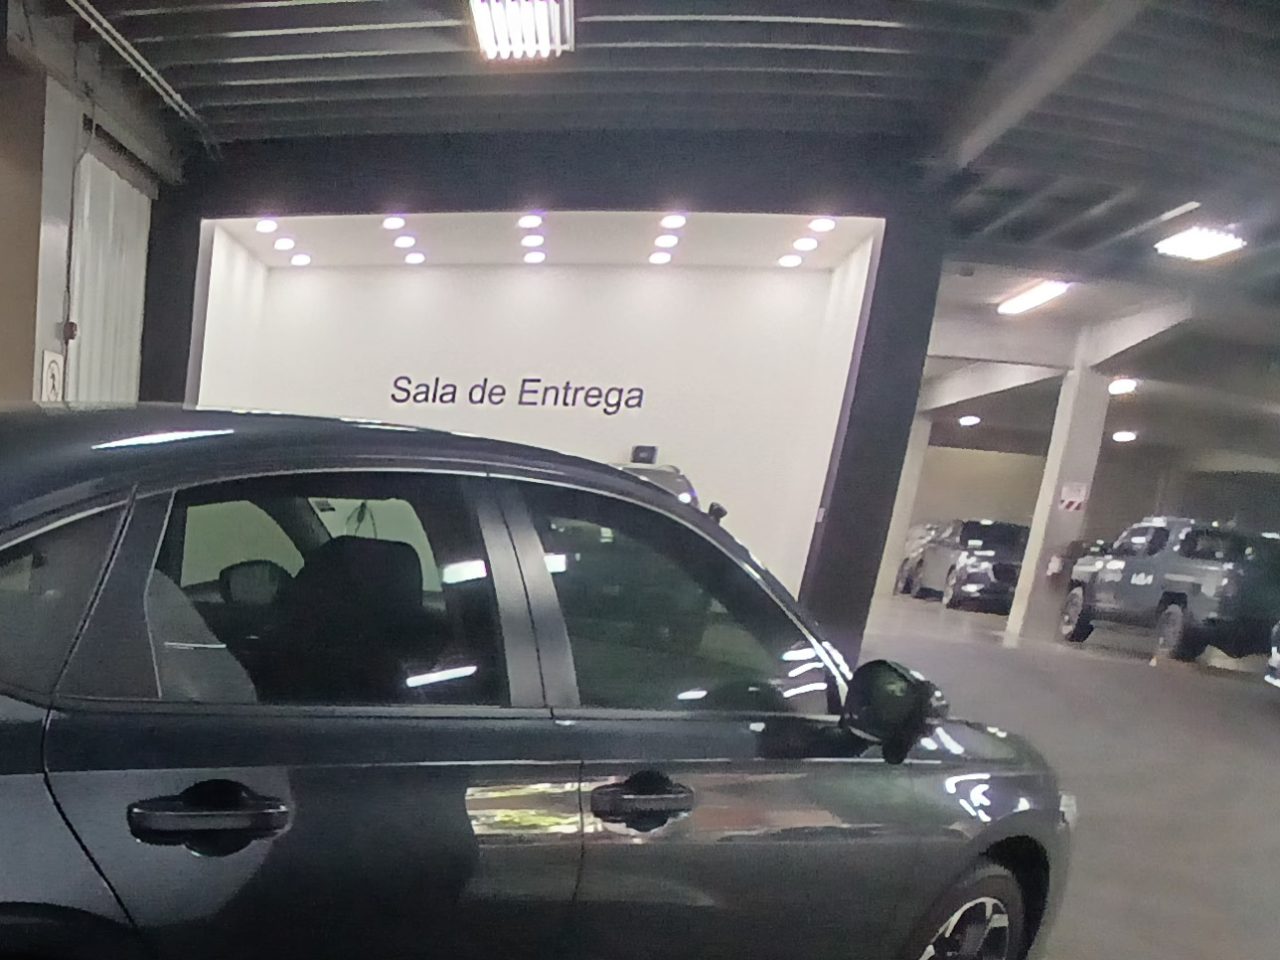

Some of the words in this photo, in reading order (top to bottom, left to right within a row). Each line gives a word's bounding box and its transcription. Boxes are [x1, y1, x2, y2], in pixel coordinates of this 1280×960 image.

[390, 376, 457, 404] Sala
[468, 377, 507, 405] de
[518, 378, 645, 416] Entrega
